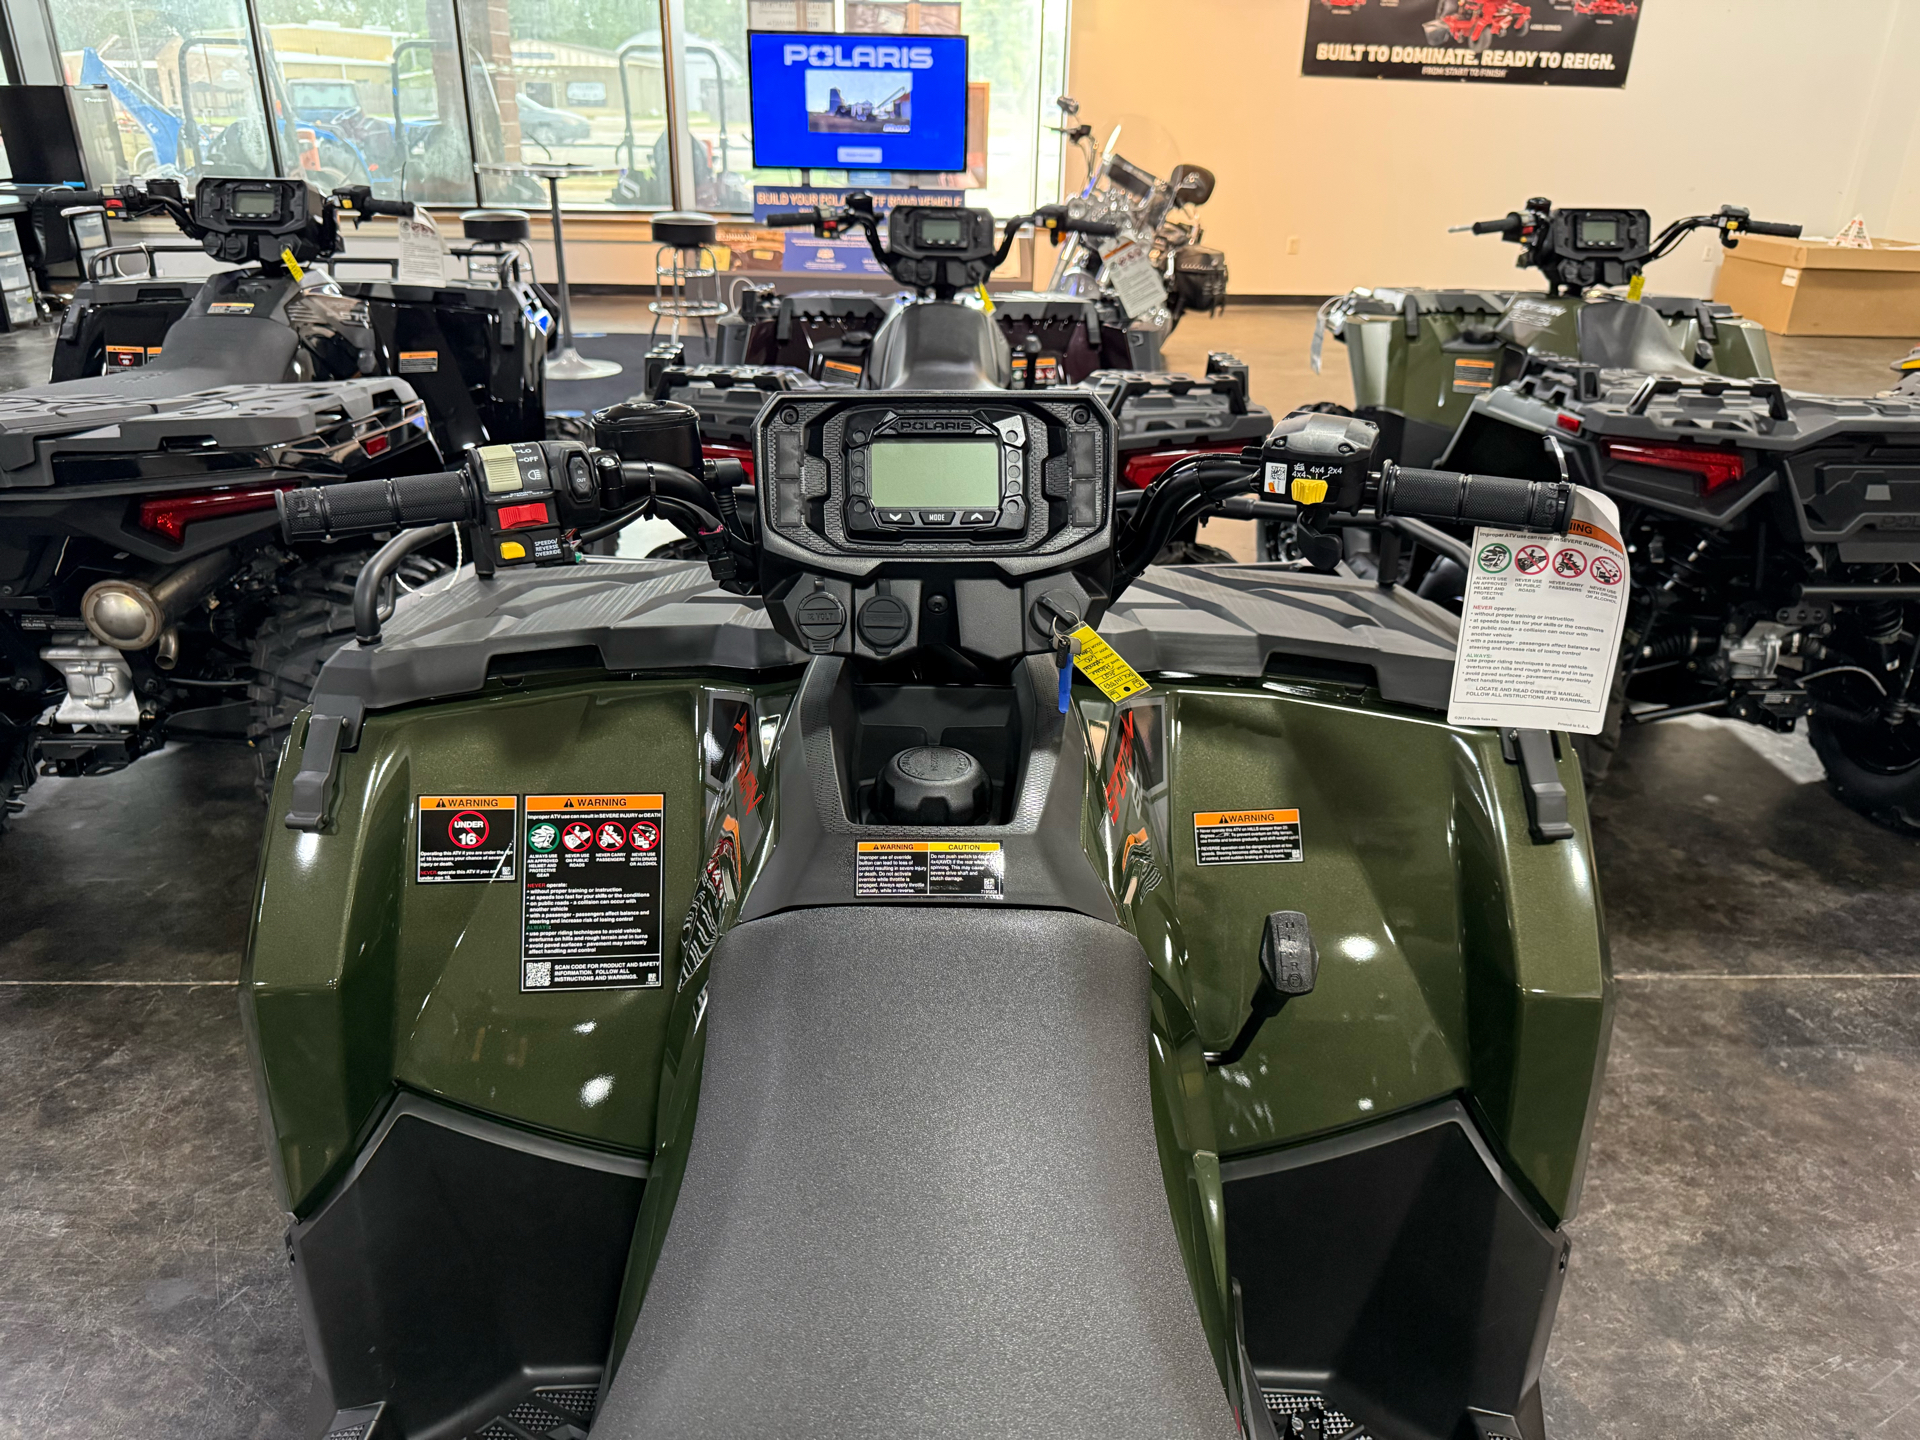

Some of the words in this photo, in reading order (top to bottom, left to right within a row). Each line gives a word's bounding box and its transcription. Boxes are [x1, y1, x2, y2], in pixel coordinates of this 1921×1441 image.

[784, 44, 933, 68] POLARIS
[1317, 44, 1365, 61] BUILT
[1367, 46, 1389, 62] TO
[1391, 46, 1478, 66] DOMINATE.
[1481, 51, 1538, 67] READY
[1539, 53, 1562, 68] TO
[1564, 53, 1615, 70] REIGN.
[820, 194, 846, 207] POLA
[340, 312, 370, 322] 570
[900, 420, 973, 431] POLARIS
[929, 513, 945, 521] MODE
[534, 538, 558, 546] SPEEDO/
[1583, 541, 1603, 550] INJURY
[1559, 696, 1592, 704] WARNINGS.
[448, 799, 498, 807] WARNING
[578, 799, 627, 807] WARNING
[1228, 814, 1275, 823] WARNING
[459, 833, 476, 845] 16
